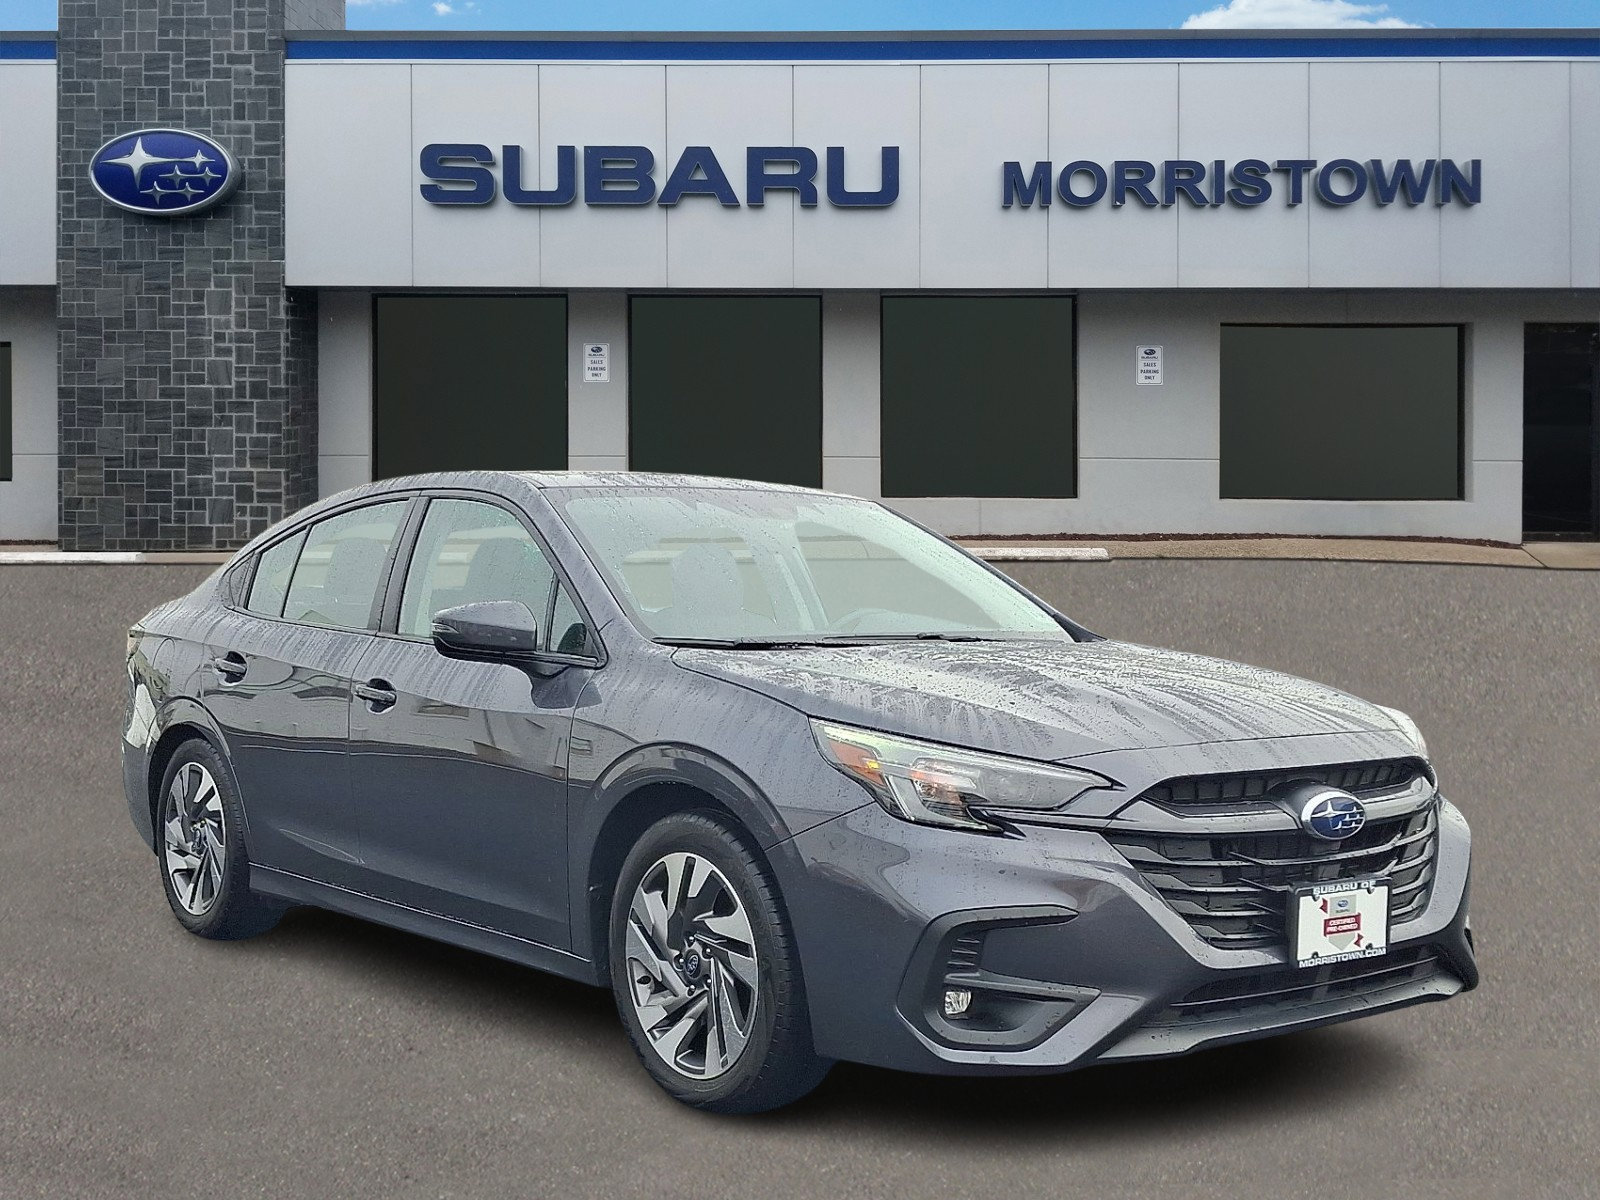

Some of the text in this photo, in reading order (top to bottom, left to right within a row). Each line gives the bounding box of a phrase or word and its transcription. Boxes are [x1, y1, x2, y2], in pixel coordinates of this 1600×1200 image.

[420, 143, 900, 207] SUBARU
[1001, 158, 1482, 208] MORRISTOWN
[1312, 880, 1376, 895] SUBARU OF
[1299, 947, 1387, 968] MORRISTOWN.COM
